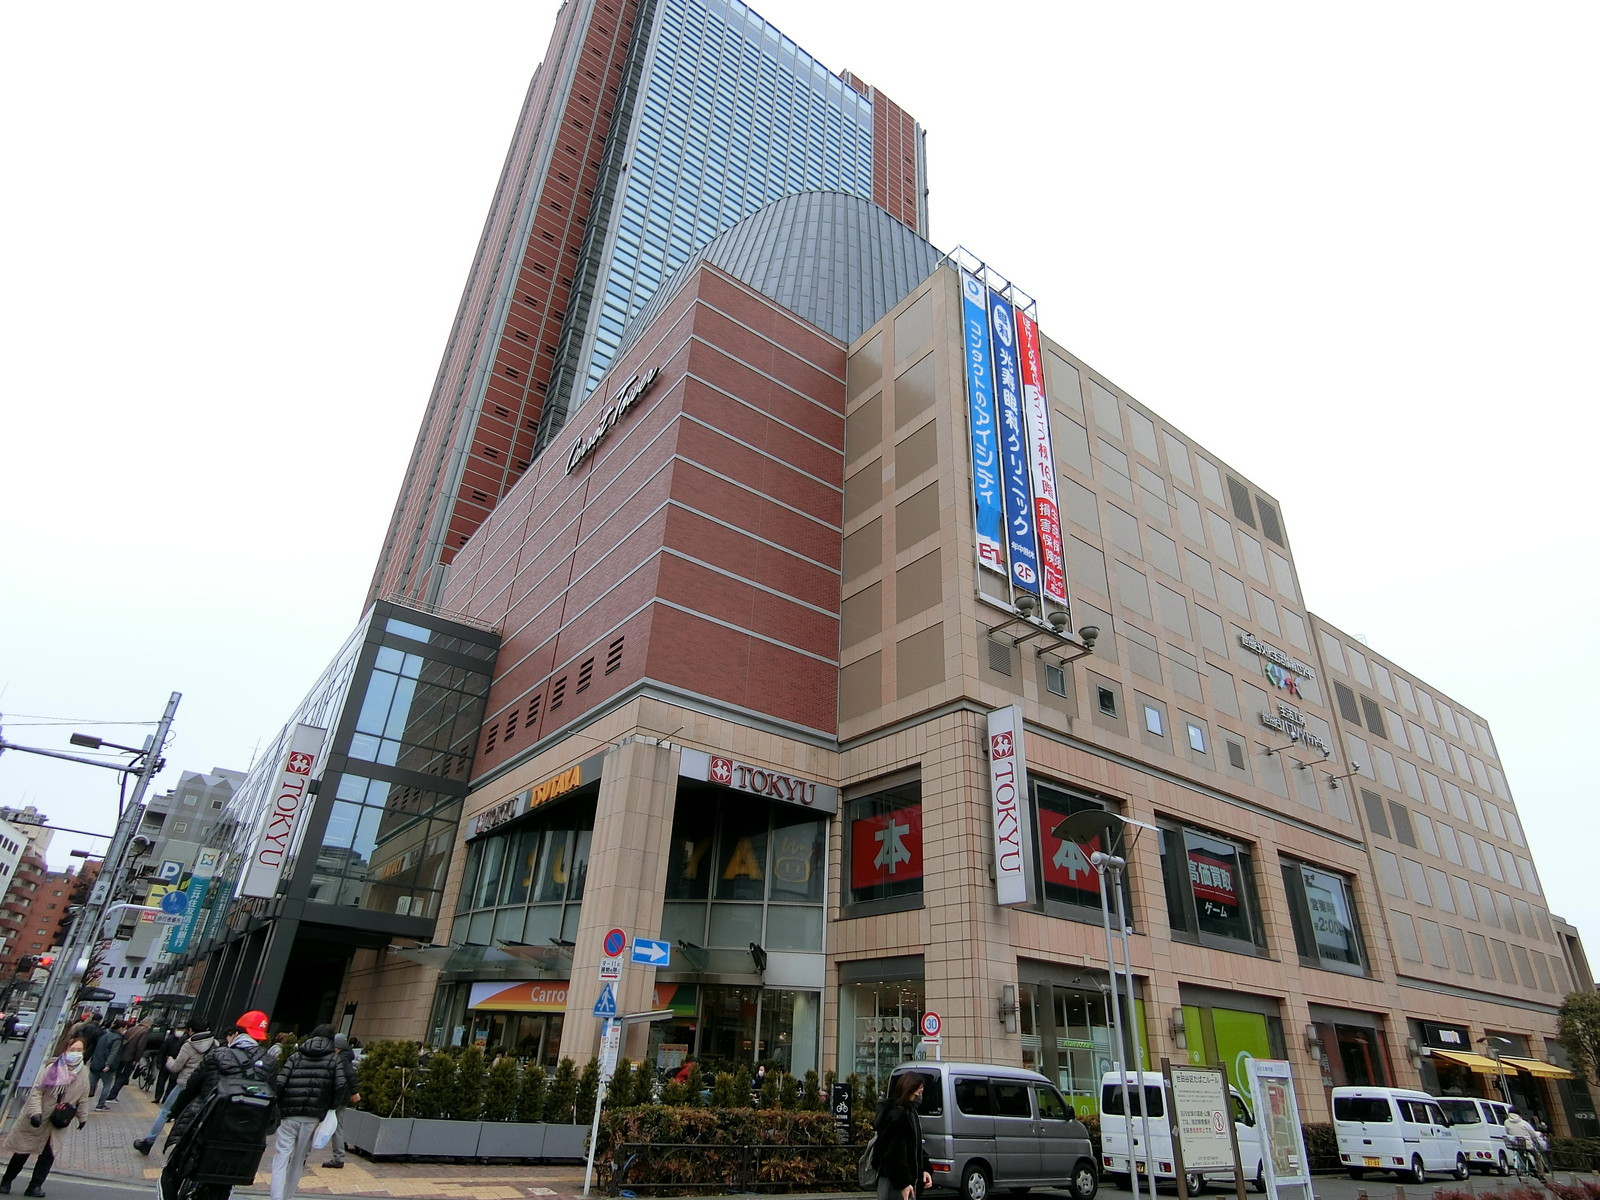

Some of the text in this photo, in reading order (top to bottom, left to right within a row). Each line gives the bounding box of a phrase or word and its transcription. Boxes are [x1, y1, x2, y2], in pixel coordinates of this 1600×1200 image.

[1017, 563, 1033, 580] 2F
[530, 765, 580, 809] TSUTAYA
[735, 765, 817, 805] TOKYU
[258, 778, 305, 869] TOKYU
[994, 761, 1021, 873] TOKYU
[873, 818, 911, 874] 本
[1051, 825, 1091, 881] 本
[160, 862, 180, 881] P
[1188, 859, 1233, 892] 高価買取
[1204, 901, 1228, 919] ゲーム
[531, 985, 568, 1003] Carro
[926, 1018, 937, 1030] 30
[1176, 1075, 1219, 1084] 世田谷区たばこルール
